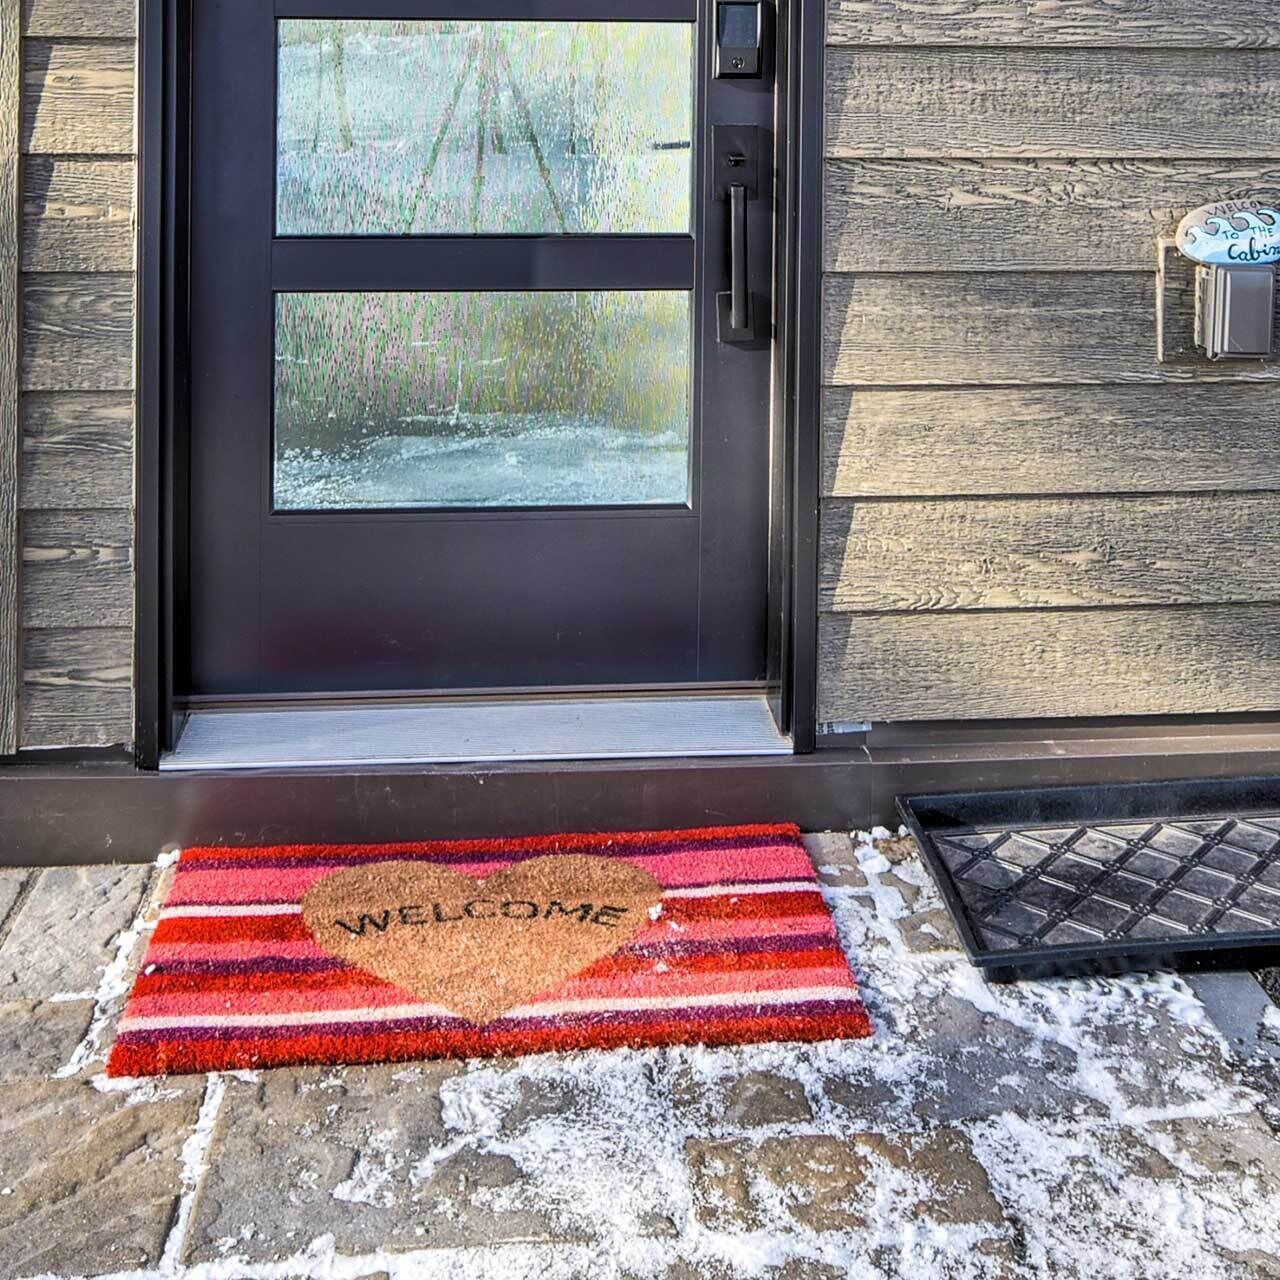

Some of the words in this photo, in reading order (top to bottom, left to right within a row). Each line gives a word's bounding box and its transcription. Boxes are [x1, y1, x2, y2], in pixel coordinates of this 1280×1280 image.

[1203, 200, 1261, 217] WELCO
[1222, 230, 1239, 239] TO
[1249, 226, 1274, 238] THE
[334, 899, 629, 937] WELCOME
